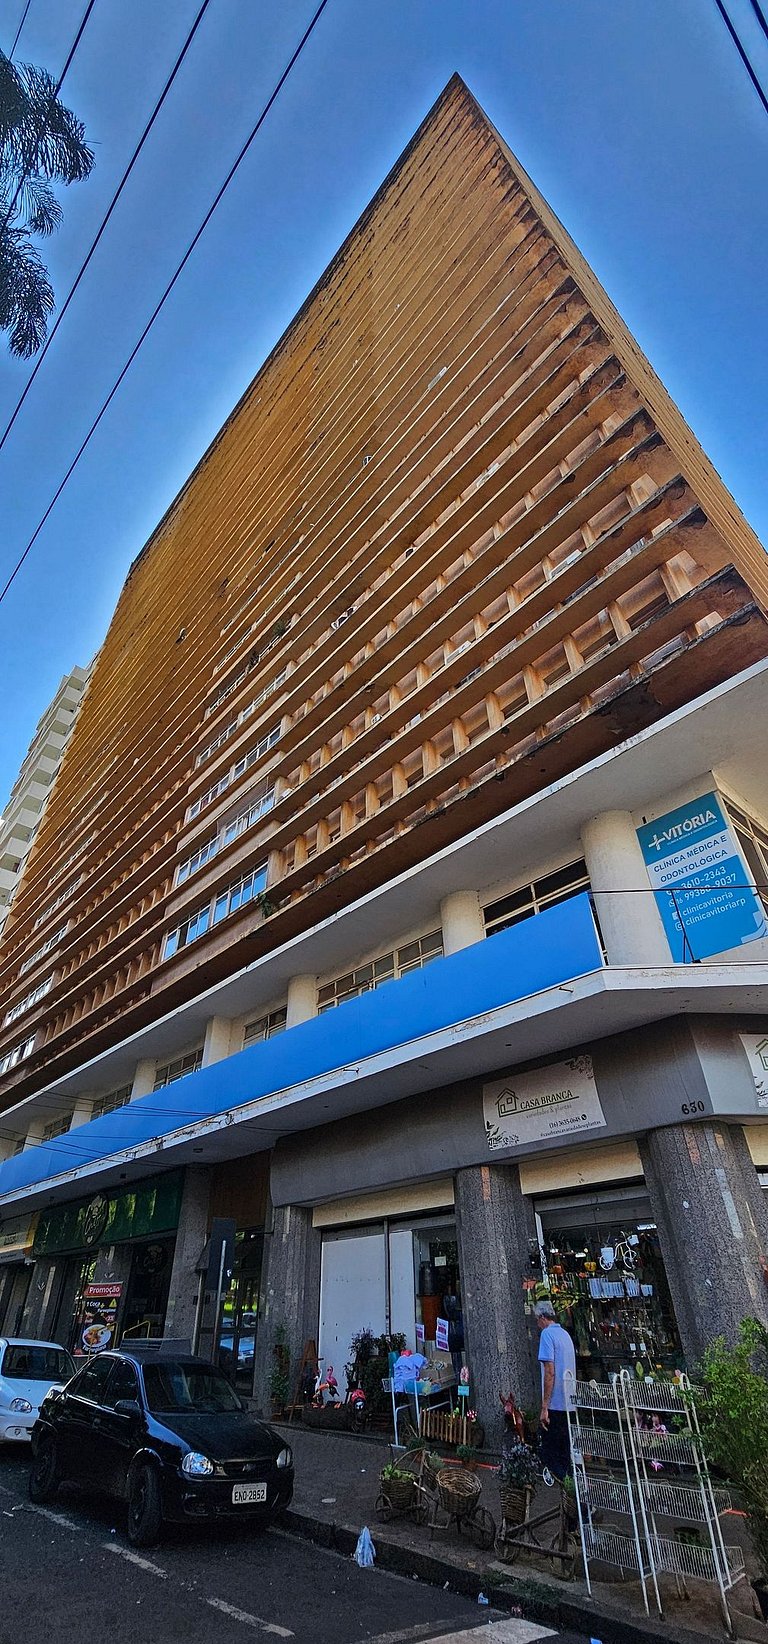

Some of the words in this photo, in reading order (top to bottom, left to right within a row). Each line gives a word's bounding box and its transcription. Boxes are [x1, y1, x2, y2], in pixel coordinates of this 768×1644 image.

[662, 810, 717, 840] VITÓRIA
[654, 854, 686, 873] CLÍNICA
[686, 840, 720, 858] MÉDICA
[720, 835, 727, 843] E
[660, 849, 728, 882] ODONTOLÓGICA
[681, 866, 726, 889] 3610-2343
[682, 891, 734, 916] clinicavitoria
[685, 898, 746, 926] clinicavitoriarp
[520, 1098, 540, 1110] CASA
[540, 1090, 573, 1105] BRANCA
[89, 1285, 120, 1294] Promoção
